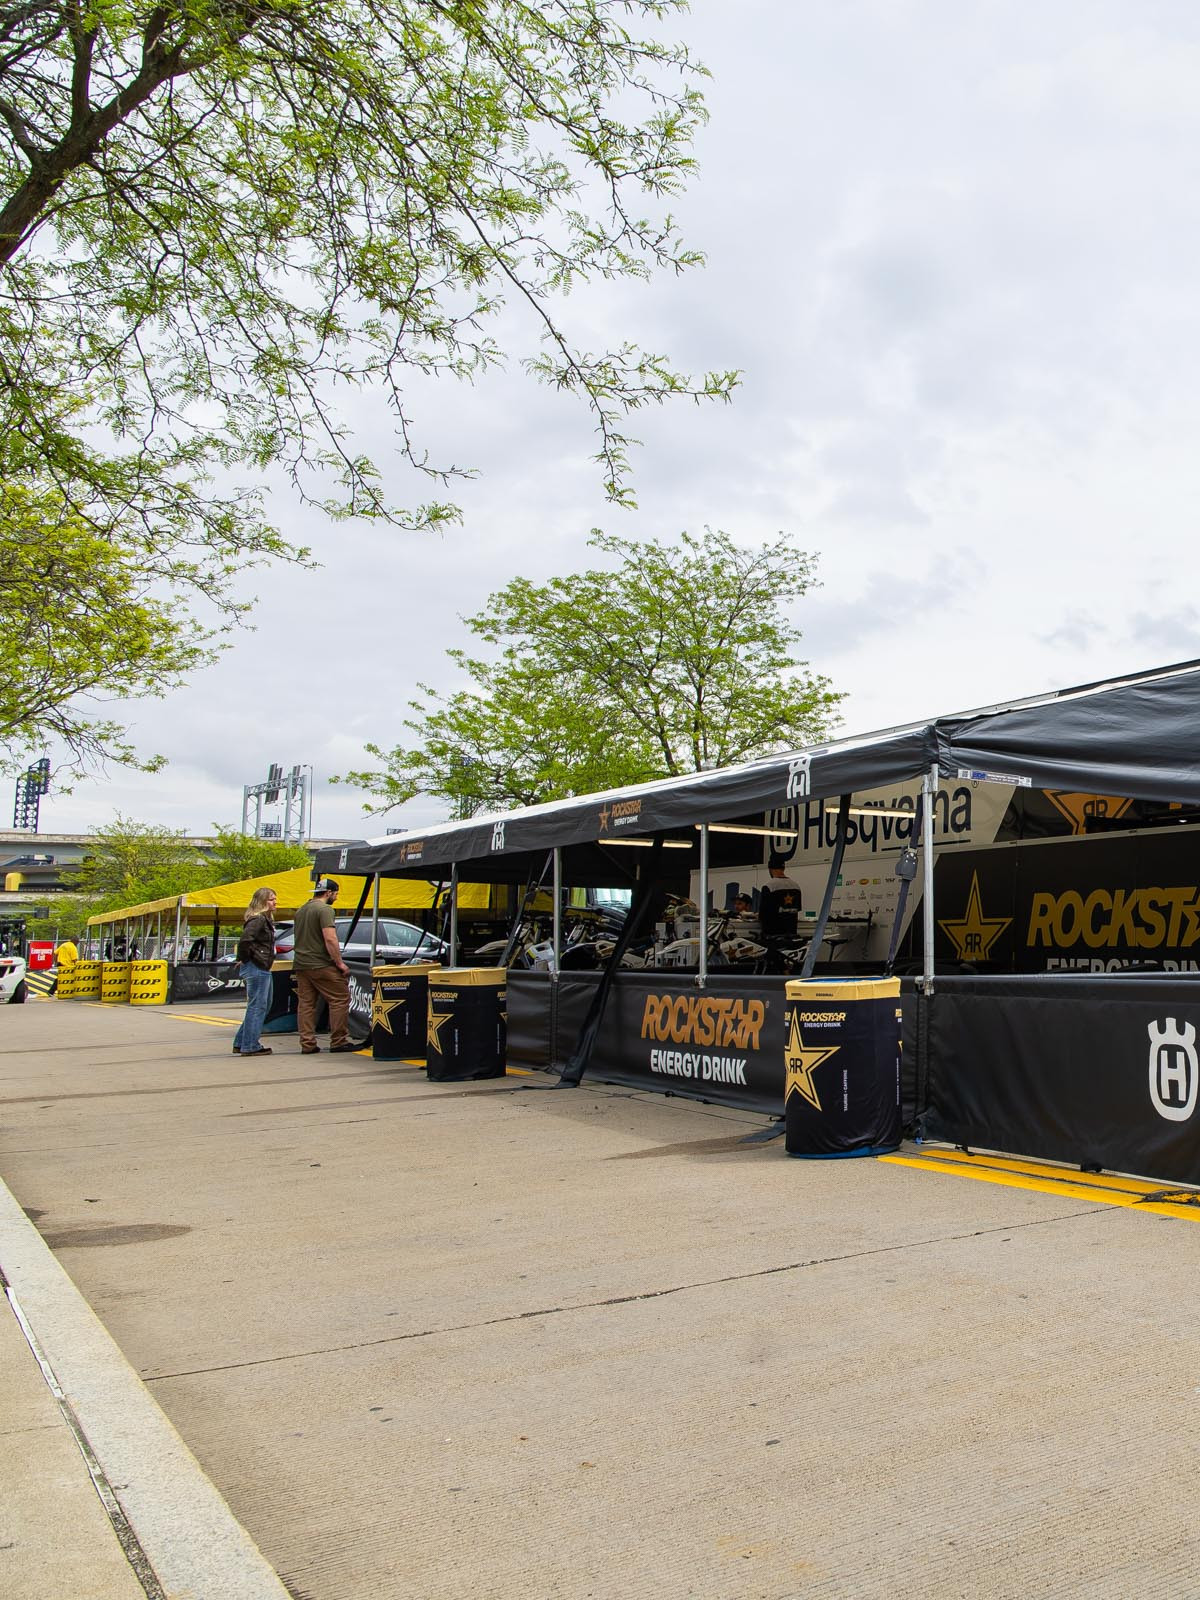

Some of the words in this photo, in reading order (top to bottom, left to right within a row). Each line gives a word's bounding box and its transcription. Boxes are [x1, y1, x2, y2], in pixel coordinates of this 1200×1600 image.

[803, 786, 971, 852] Husqvana
[641, 994, 765, 1050] ROCKSTAR
[800, 1012, 846, 1022] ROCKSTAR
[650, 1049, 701, 1079] ENERGY
[702, 1055, 747, 1085] DRINK
